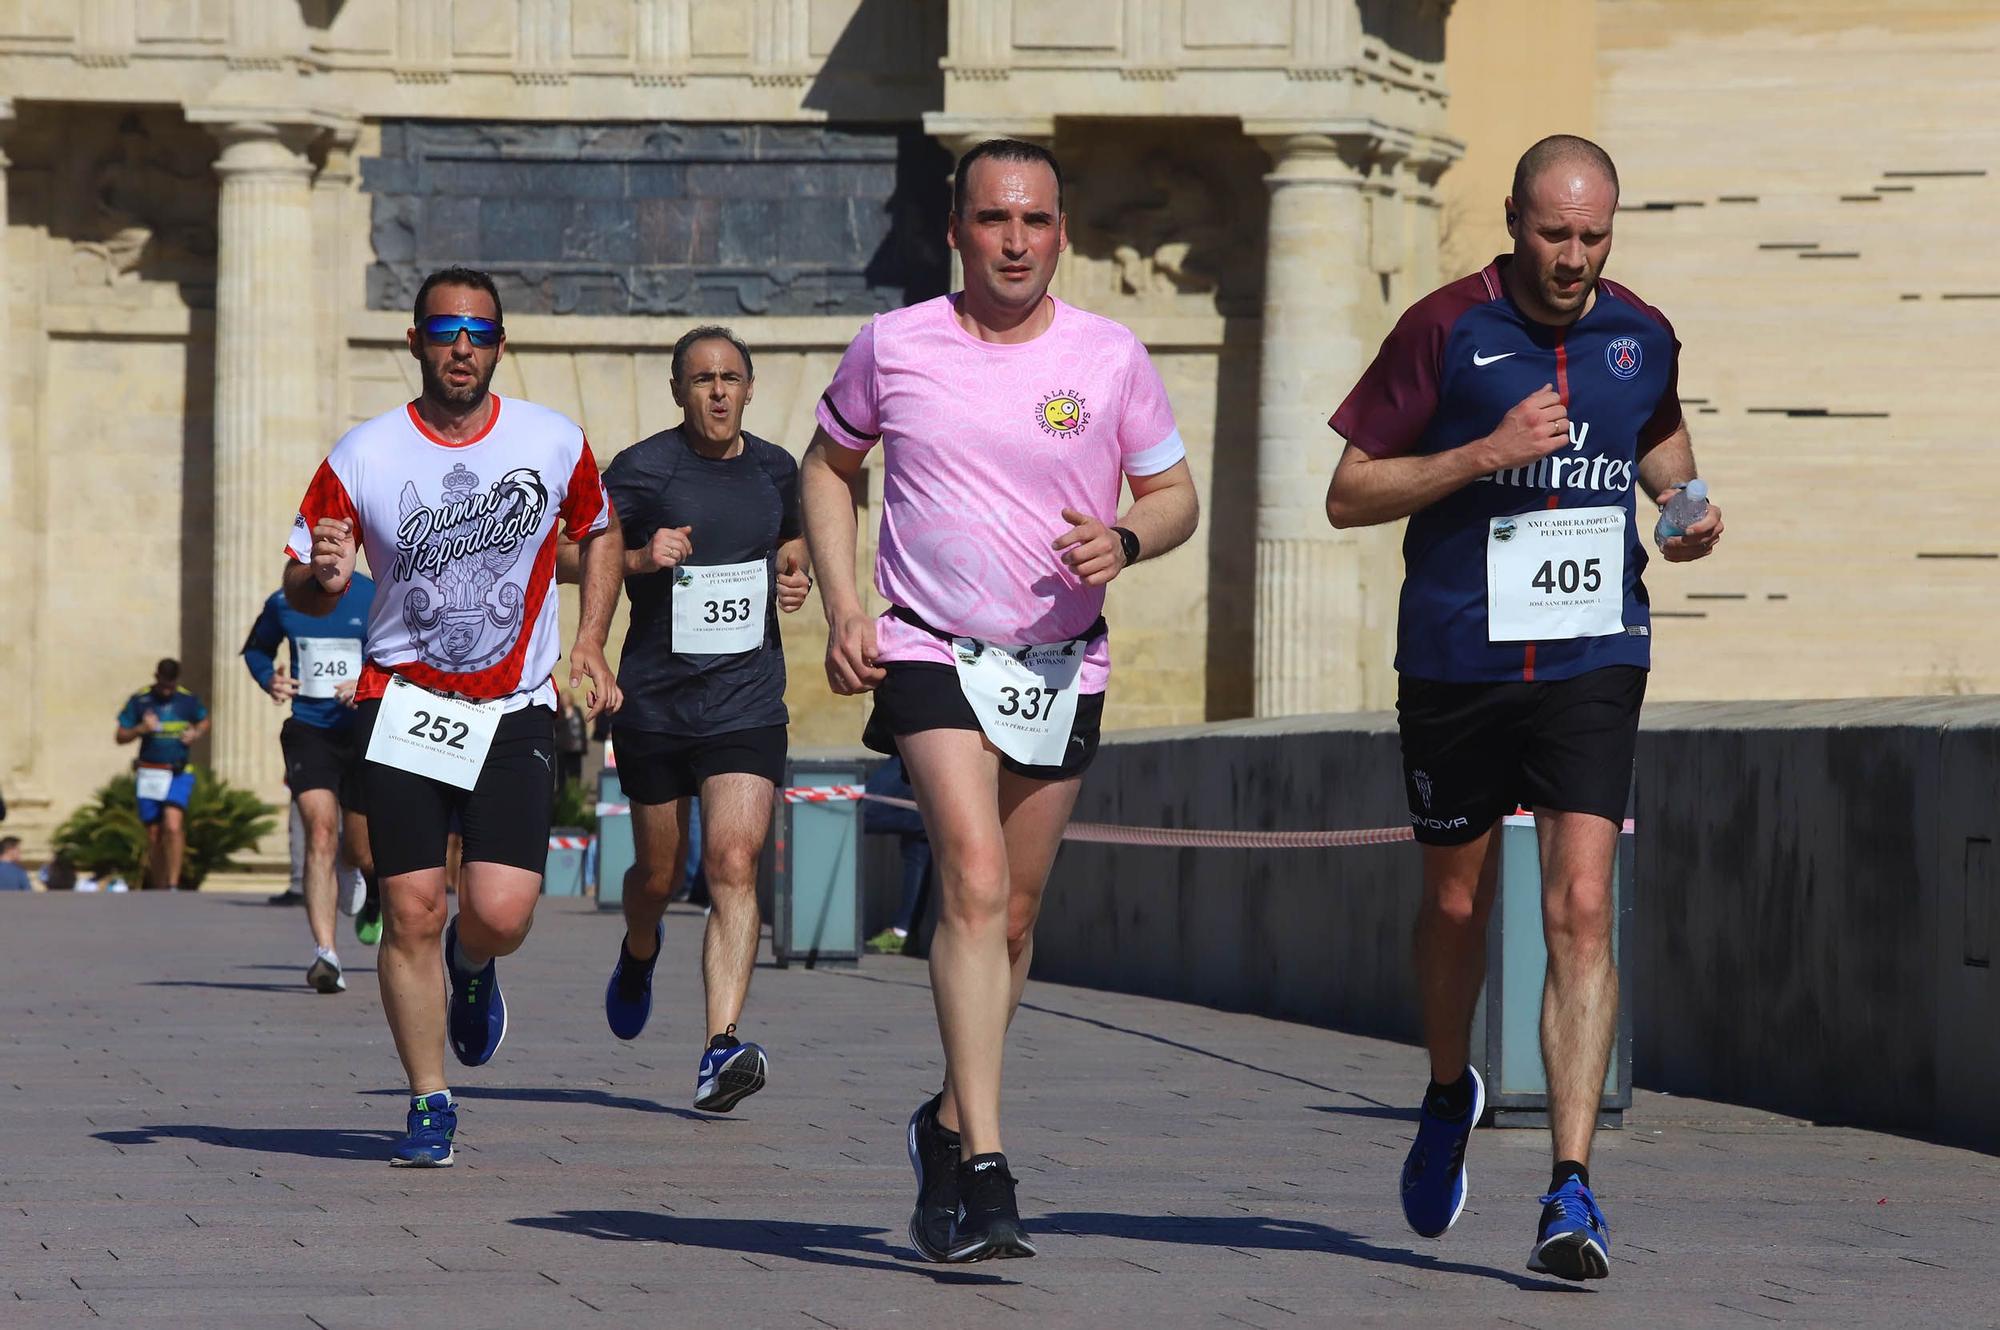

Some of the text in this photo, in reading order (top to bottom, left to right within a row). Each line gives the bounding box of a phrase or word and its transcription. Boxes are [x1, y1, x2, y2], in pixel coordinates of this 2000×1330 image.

[1613, 341, 1635, 349] PARIS
[1052, 389, 1064, 397] LA
[1035, 403, 1056, 437] LENGUA
[1073, 412, 1090, 435] SACA
[1475, 452, 1633, 492] mirates
[397, 482, 501, 545] Dumni
[1532, 558, 1601, 594] 405
[704, 598, 750, 623] 353
[314, 661, 347, 676] 248
[998, 687, 1058, 720] 337
[408, 711, 468, 749] 252
